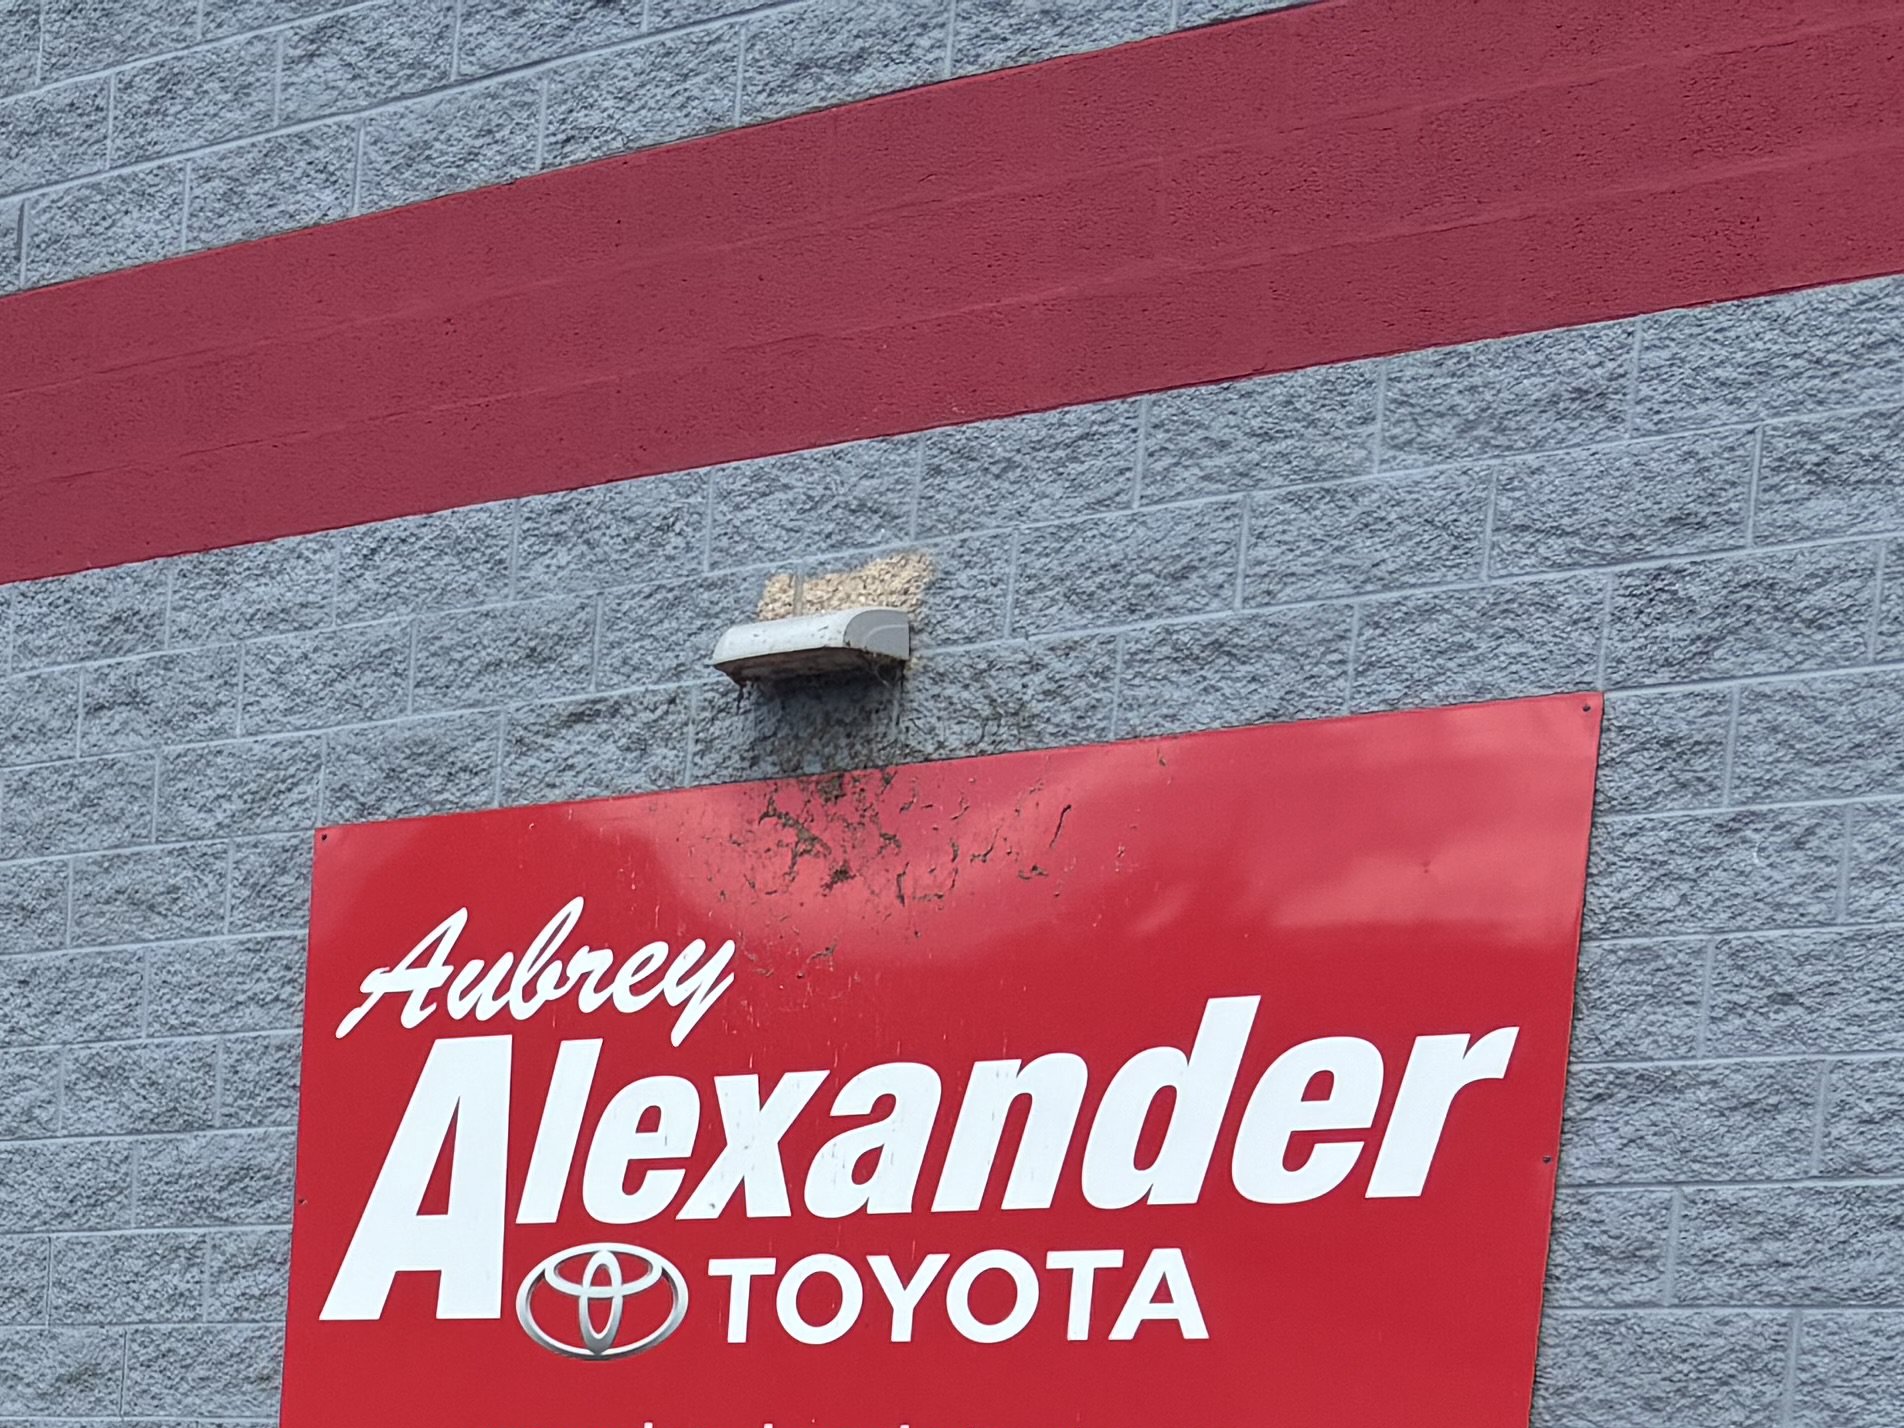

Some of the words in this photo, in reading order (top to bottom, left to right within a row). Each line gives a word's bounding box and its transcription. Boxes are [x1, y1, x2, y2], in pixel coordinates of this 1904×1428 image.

[336, 896, 736, 1048] Aubrey
[319, 996, 1520, 1321] Alexander
[707, 1248, 1210, 1345] TOYOTA
